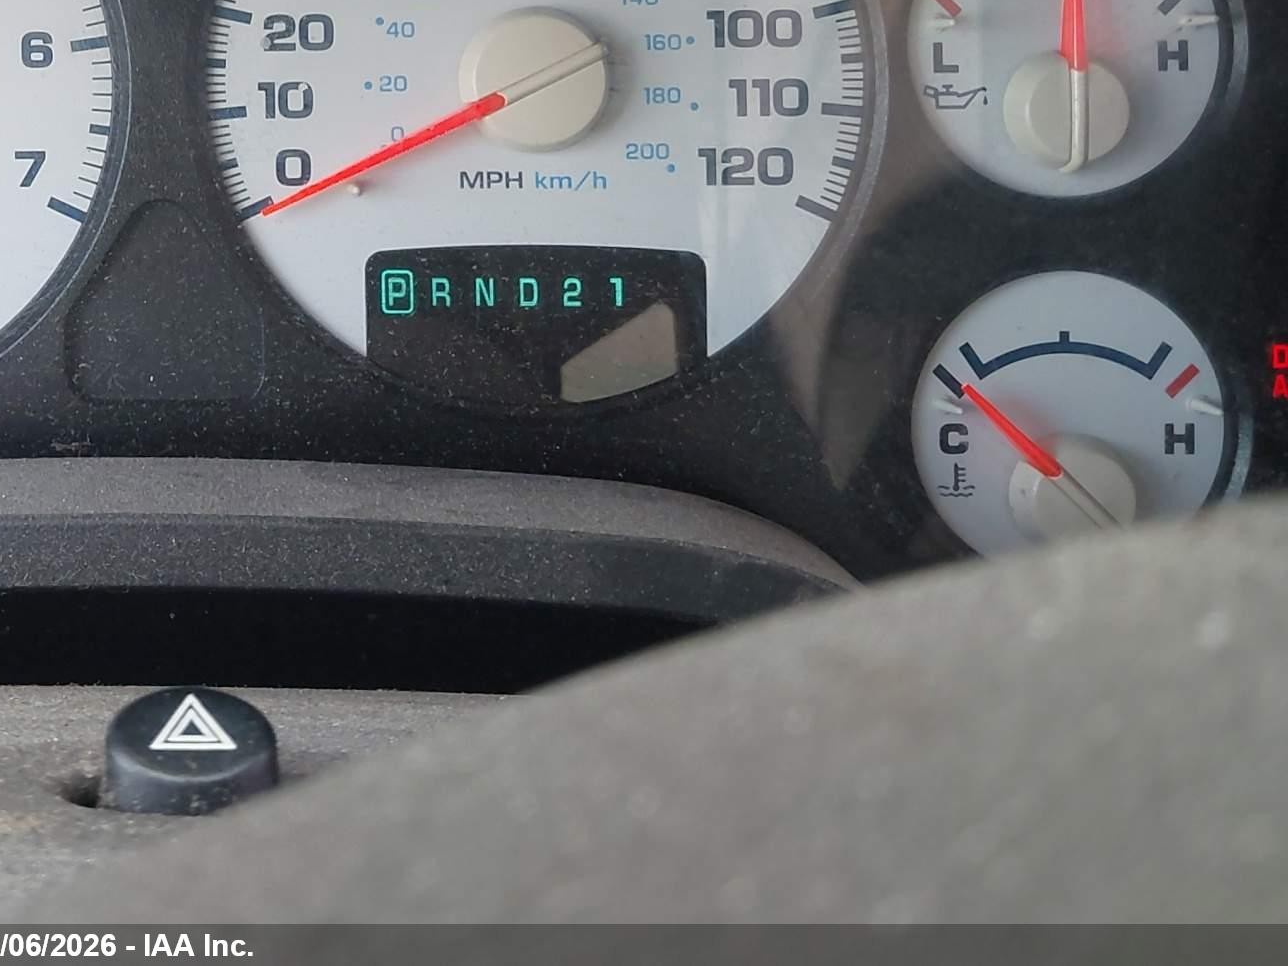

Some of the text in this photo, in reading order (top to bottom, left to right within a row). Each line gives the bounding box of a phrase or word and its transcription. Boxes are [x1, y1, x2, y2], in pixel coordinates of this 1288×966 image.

[264, 14, 335, 51] 20
[387, 21, 415, 39] 40
[645, 34, 681, 51] 160
[706, 10, 802, 48] 100
[20, 31, 54, 69] 6
[933, 42, 959, 74] L
[1158, 40, 1188, 71] H
[258, 81, 314, 119] 10
[379, 75, 408, 93] 20
[644, 87, 680, 104] 180
[728, 79, 809, 117] 110
[391, 126, 404, 142] 0
[275, 148, 311, 186] 0
[626, 143, 670, 161] 200
[697, 147, 794, 185] 120
[14, 150, 47, 188] 7
[459, 170, 607, 190] MPH km/h
[387, 277, 624, 307] P R N D 2 1
[939, 423, 969, 455] C
[1164, 423, 1195, 455] H
